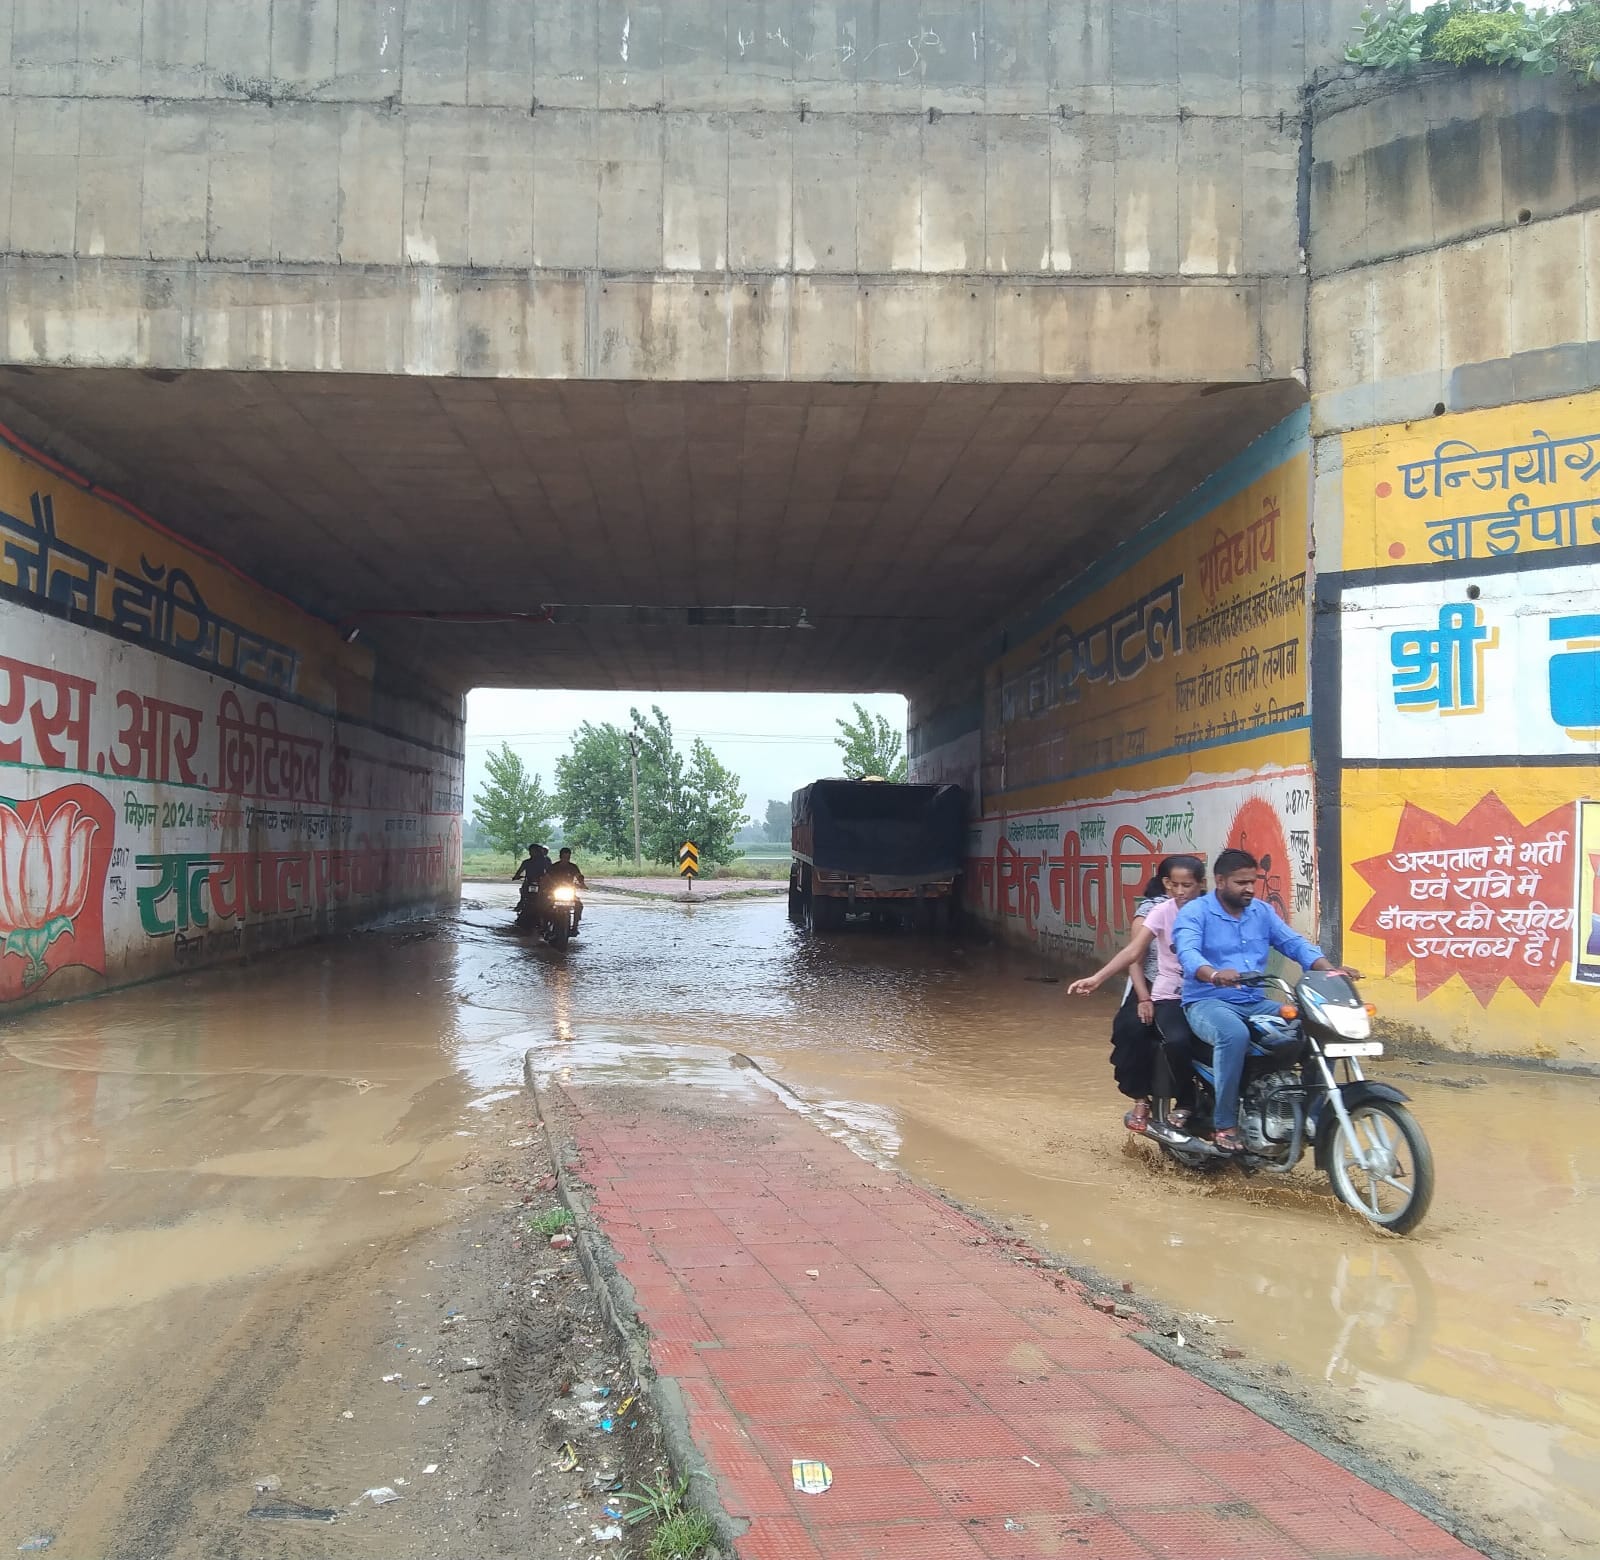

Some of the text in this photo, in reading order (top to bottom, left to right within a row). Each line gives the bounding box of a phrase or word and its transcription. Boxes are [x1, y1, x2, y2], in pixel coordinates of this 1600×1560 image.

[1426, 493, 1600, 560] बाईपा
[1391, 603, 1498, 716] श्री
[162, 802, 194, 828] 2024
[1388, 831, 1570, 873] अस्पताल में भर्ती
[1409, 866, 1543, 901] एवं रात्रि में
[1376, 904, 1456, 935] डॉक्टर
[1456, 901, 1496, 931] की
[1406, 937, 1520, 959] उपलब्ध
